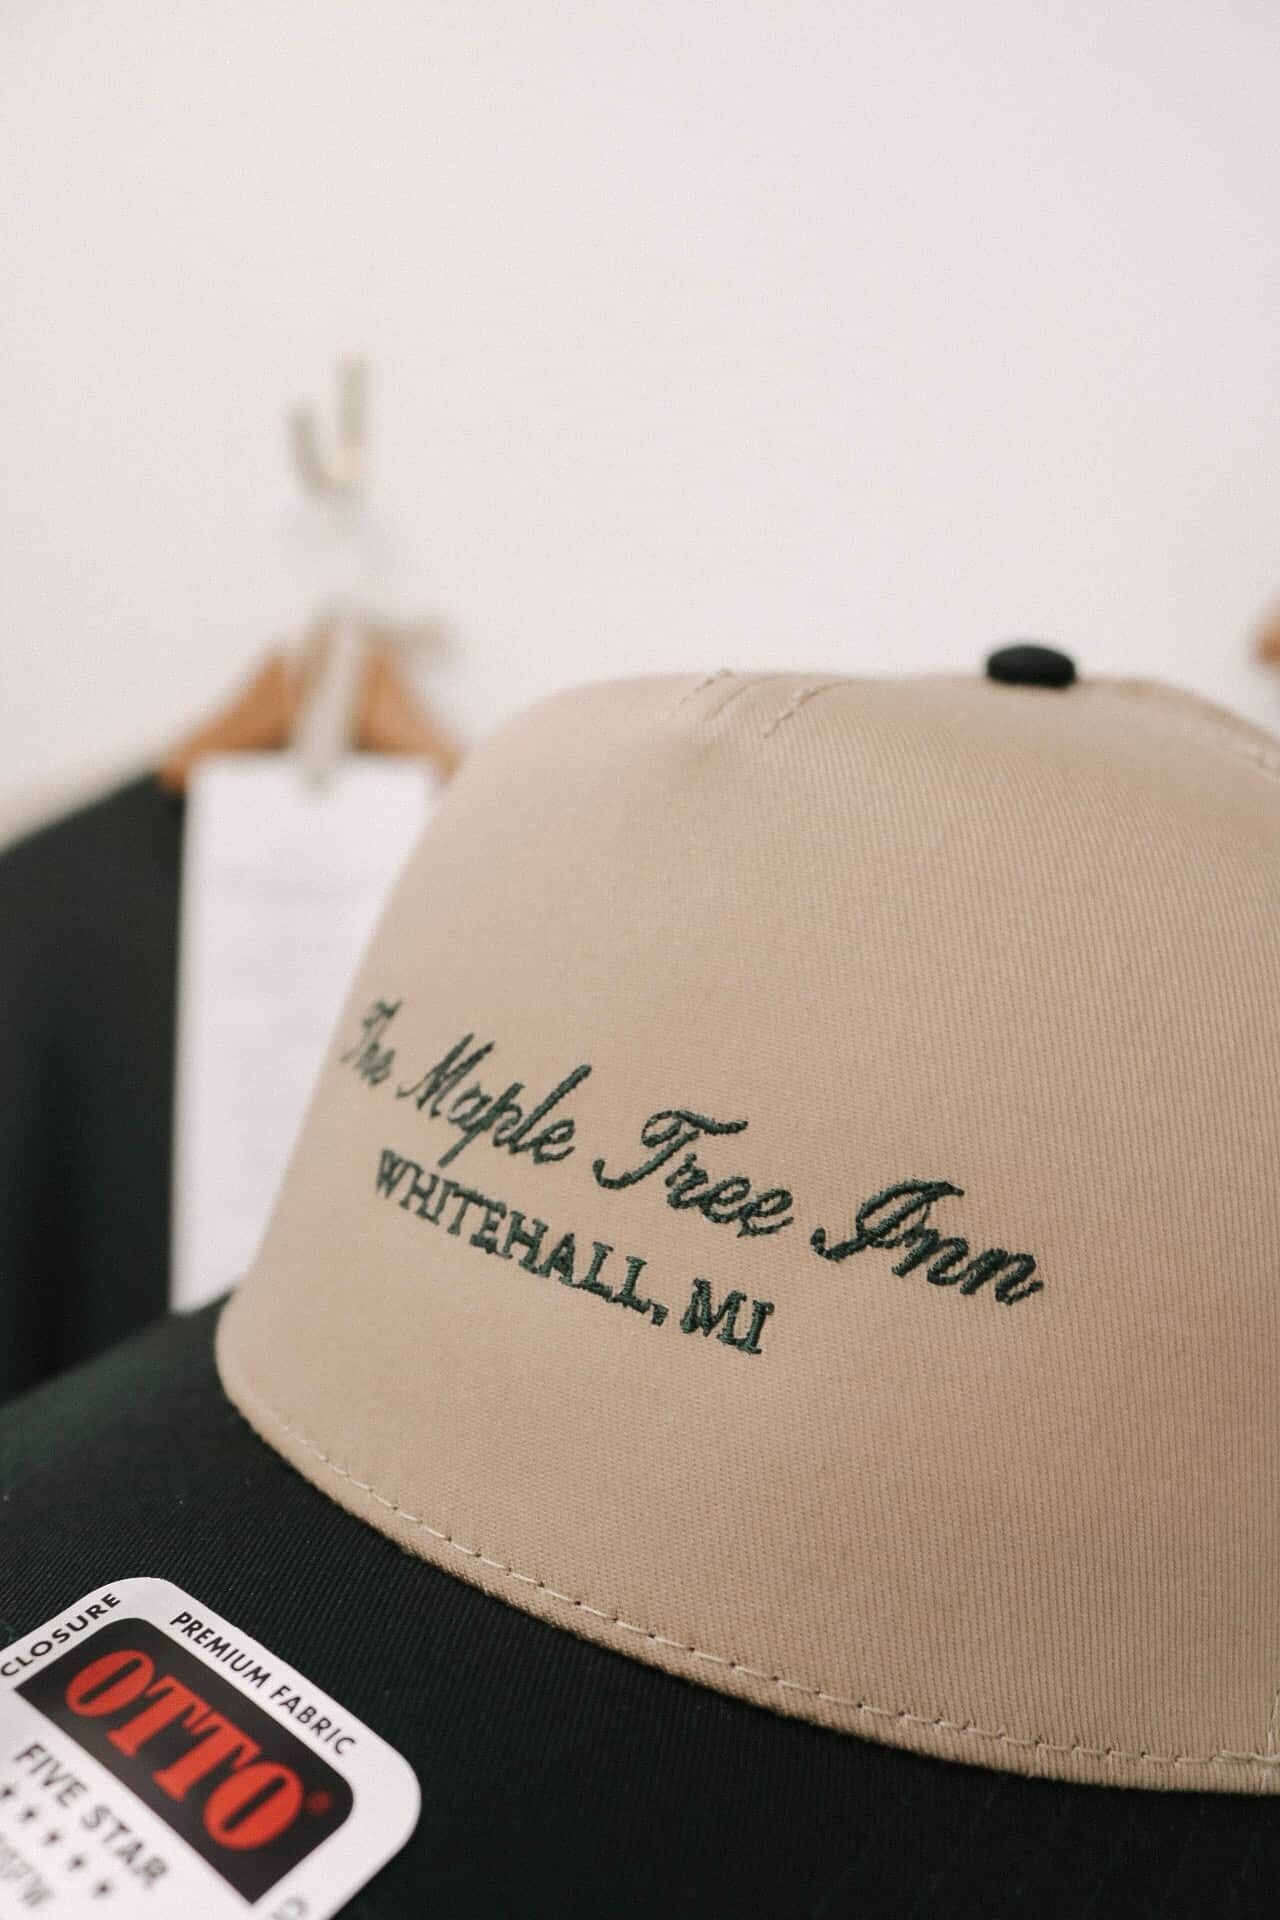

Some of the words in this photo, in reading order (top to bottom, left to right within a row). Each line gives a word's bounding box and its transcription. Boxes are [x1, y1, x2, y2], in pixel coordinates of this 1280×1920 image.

[341, 999, 402, 1086] The
[395, 1032, 592, 1167] Maple
[592, 1109, 794, 1238] Tree
[811, 1178, 1044, 1305] Inn
[375, 1148, 668, 1325] WHITEHALL,
[679, 1278, 775, 1355] MI
[1, 1593, 121, 1677] CLOSURE
[169, 1611, 268, 1689] PREMIUM
[270, 1684, 356, 1757] FABRIC
[14, 1743, 89, 1808] FIVE
[81, 1804, 170, 1890] STAR
[65, 1650, 303, 1850] OTTO
